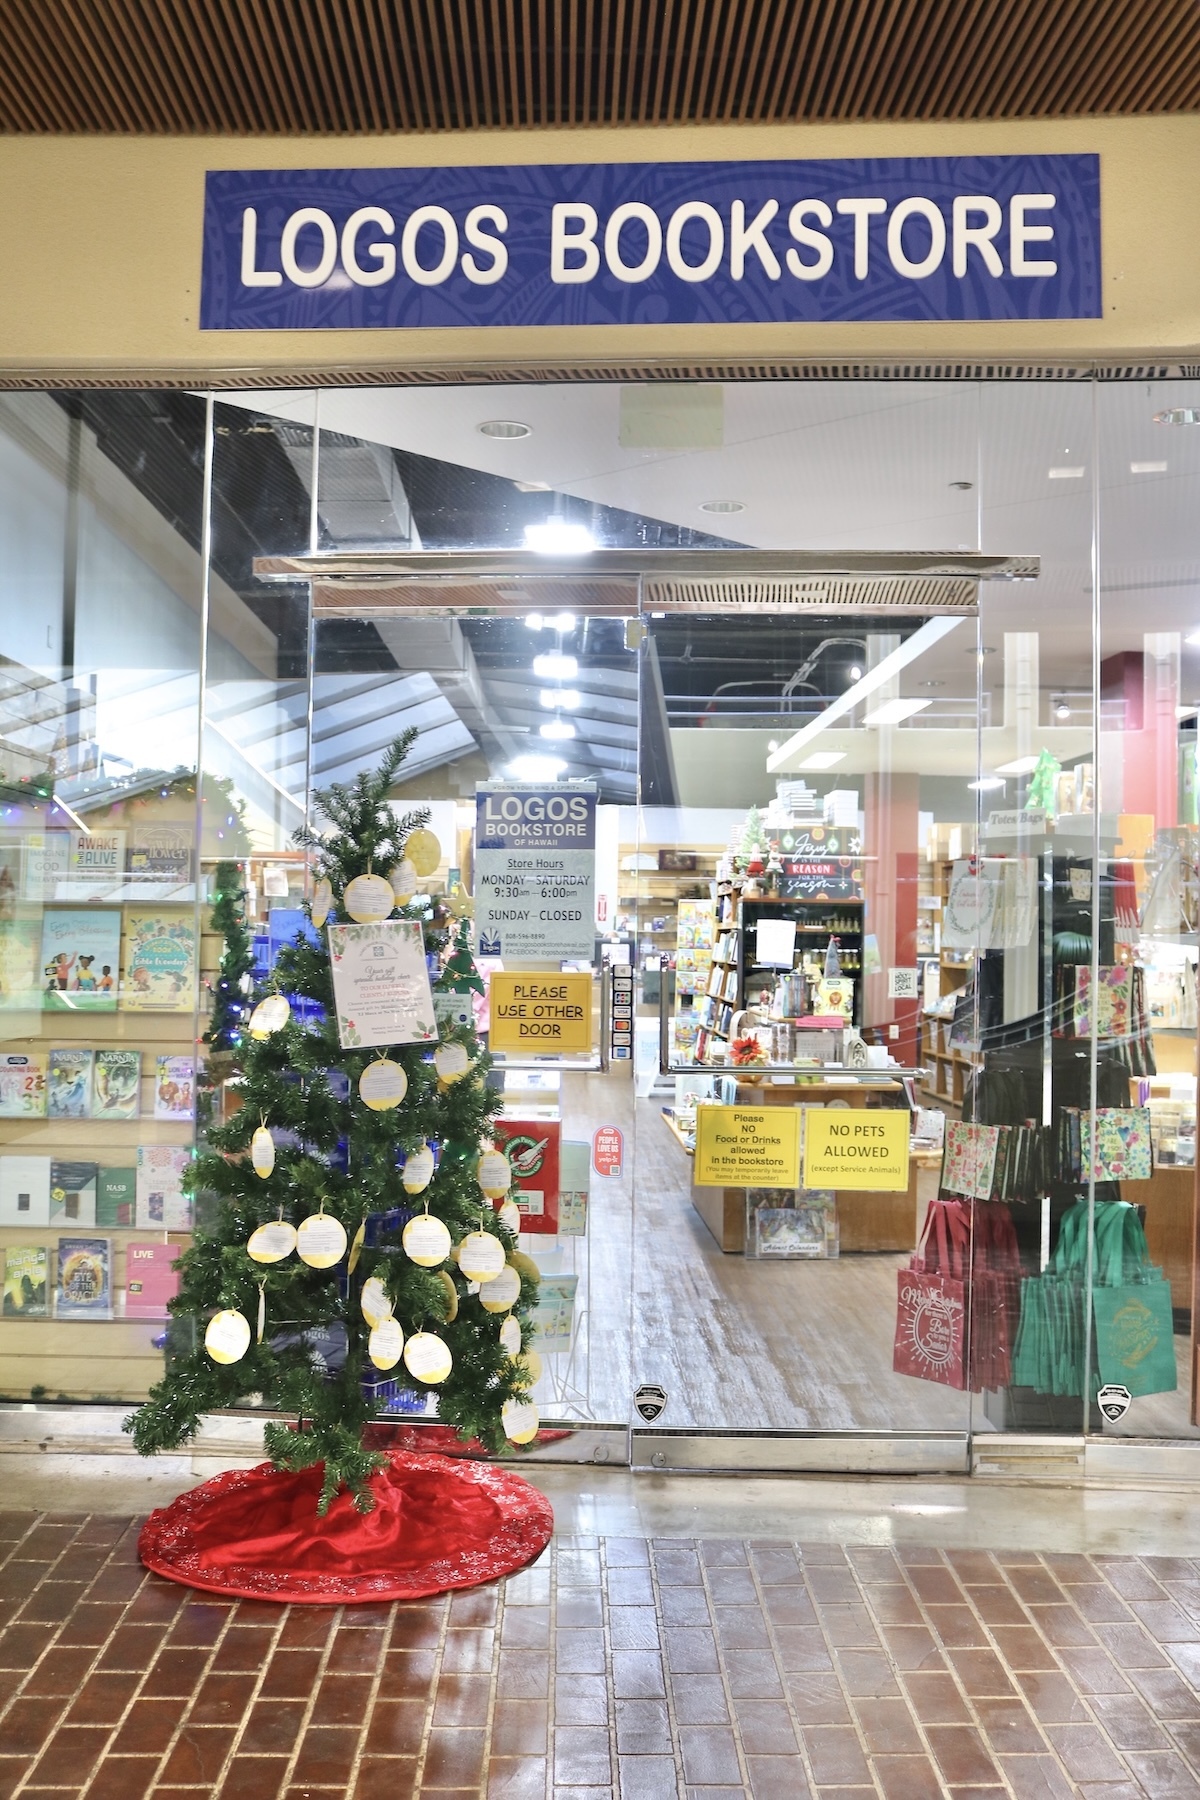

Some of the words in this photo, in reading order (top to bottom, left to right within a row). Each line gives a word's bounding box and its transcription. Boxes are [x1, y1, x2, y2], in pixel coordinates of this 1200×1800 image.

[241, 204, 509, 288] LOGOS
[550, 193, 1059, 285] BOOKSTORE
[486, 796, 588, 820] LOGOS
[991, 814, 1016, 825] Totes
[1020, 812, 1044, 825] Bags
[486, 823, 587, 836] BOOKSTORE
[78, 838, 118, 850] AWAKE
[85, 852, 117, 864] ALIVE
[508, 858, 534, 868] Store
[536, 859, 564, 868] Hours
[34, 862, 60, 872] GOD
[792, 864, 830, 874] REASON
[482, 874, 526, 886] MONDAY
[536, 875, 590, 886] SATURDAY
[494, 887, 530, 898] 9:30am
[541, 888, 578, 898] 6:00pm
[488, 910, 530, 920] SUNDAY
[540, 910, 582, 920] CLOSED
[514, 986, 568, 998] PLEASE
[498, 1005, 527, 1017] USE
[533, 1006, 584, 1018] OTHER
[520, 1024, 561, 1036] DOOR
[54, 1053, 89, 1062] NARNIA
[100, 1053, 135, 1063] NARNIA
[25, 1076, 34, 1090] 2
[734, 1114, 764, 1123] Please
[742, 1125, 756, 1133] NO
[830, 1125, 850, 1136] NO
[854, 1126, 885, 1137] PETS
[598, 1136, 618, 1144] PEOPLE
[716, 1135, 738, 1143] Food
[752, 1136, 781, 1144] Drinks
[598, 1144, 611, 1153] LOVE
[612, 1145, 619, 1153] US
[730, 1146, 766, 1154] allowed
[824, 1146, 889, 1158] ALLOWED
[722, 1156, 736, 1164] the
[739, 1157, 784, 1166] bookstore
[811, 1165, 838, 1173] (except
[868, 1166, 901, 1174] Animals)
[134, 1250, 154, 1258] LIVE
[6, 1252, 45, 1267] manga
[74, 1272, 92, 1282] EYE
